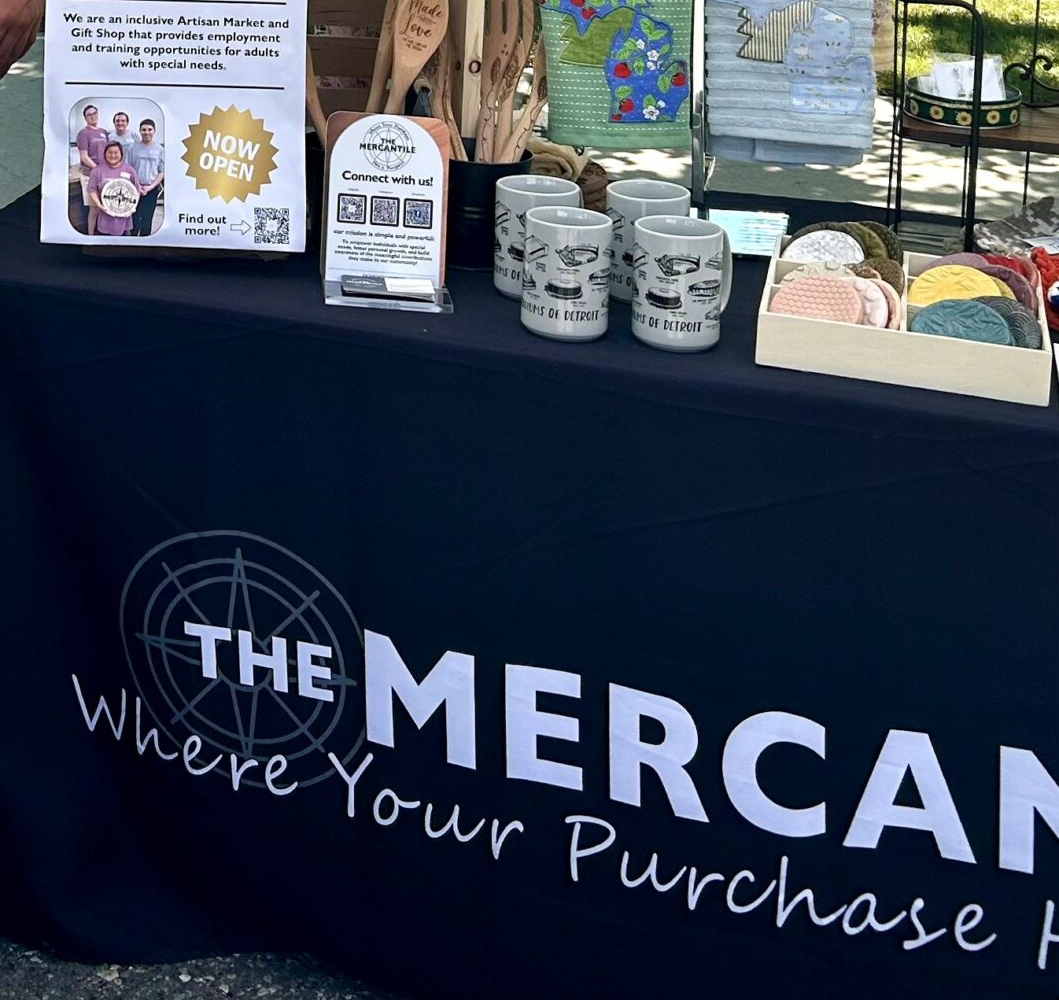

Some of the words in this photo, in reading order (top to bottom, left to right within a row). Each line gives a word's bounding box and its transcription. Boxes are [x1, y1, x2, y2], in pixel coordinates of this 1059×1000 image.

[63, 12, 84, 24] We
[87, 16, 106, 24] are
[108, 16, 123, 25] an
[125, 14, 175, 26] inclusive
[177, 16, 220, 27] Artisan
[223, 17, 265, 29] Market
[268, 18, 290, 30] and
[399, 14, 432, 38] Love
[71, 28, 93, 39] Gift
[96, 28, 126, 41] Shop
[128, 30, 153, 40] that
[155, 30, 204, 46] provides
[207, 32, 281, 45] employment
[71, 42, 92, 53] and
[96, 43, 141, 56] training
[143, 45, 222, 59] opportunities
[224, 46, 242, 57] for
[244, 47, 280, 59] adults
[119, 58, 145, 69] with
[148, 59, 187, 72] special
[190, 60, 227, 71] needs.
[203, 129, 261, 162] NOW
[359, 142, 417, 154] MERCANTILE
[199, 152, 255, 182] OPEN
[342, 170, 389, 184] Connect
[391, 174, 416, 186] with
[418, 176, 434, 187] us!
[178, 213, 204, 224] Find
[207, 215, 227, 225] out
[185, 226, 221, 236] more!
[548, 308, 559, 320] OF
[564, 310, 600, 322] DETROIT
[648, 316, 660, 329] OF
[663, 320, 703, 333] DETROIT
[183, 621, 334, 702] THE
[362, 628, 1059, 875] MERCAN
[72, 672, 298, 795] Where
[328, 750, 525, 860] Your
[563, 814, 997, 951] Purchase
